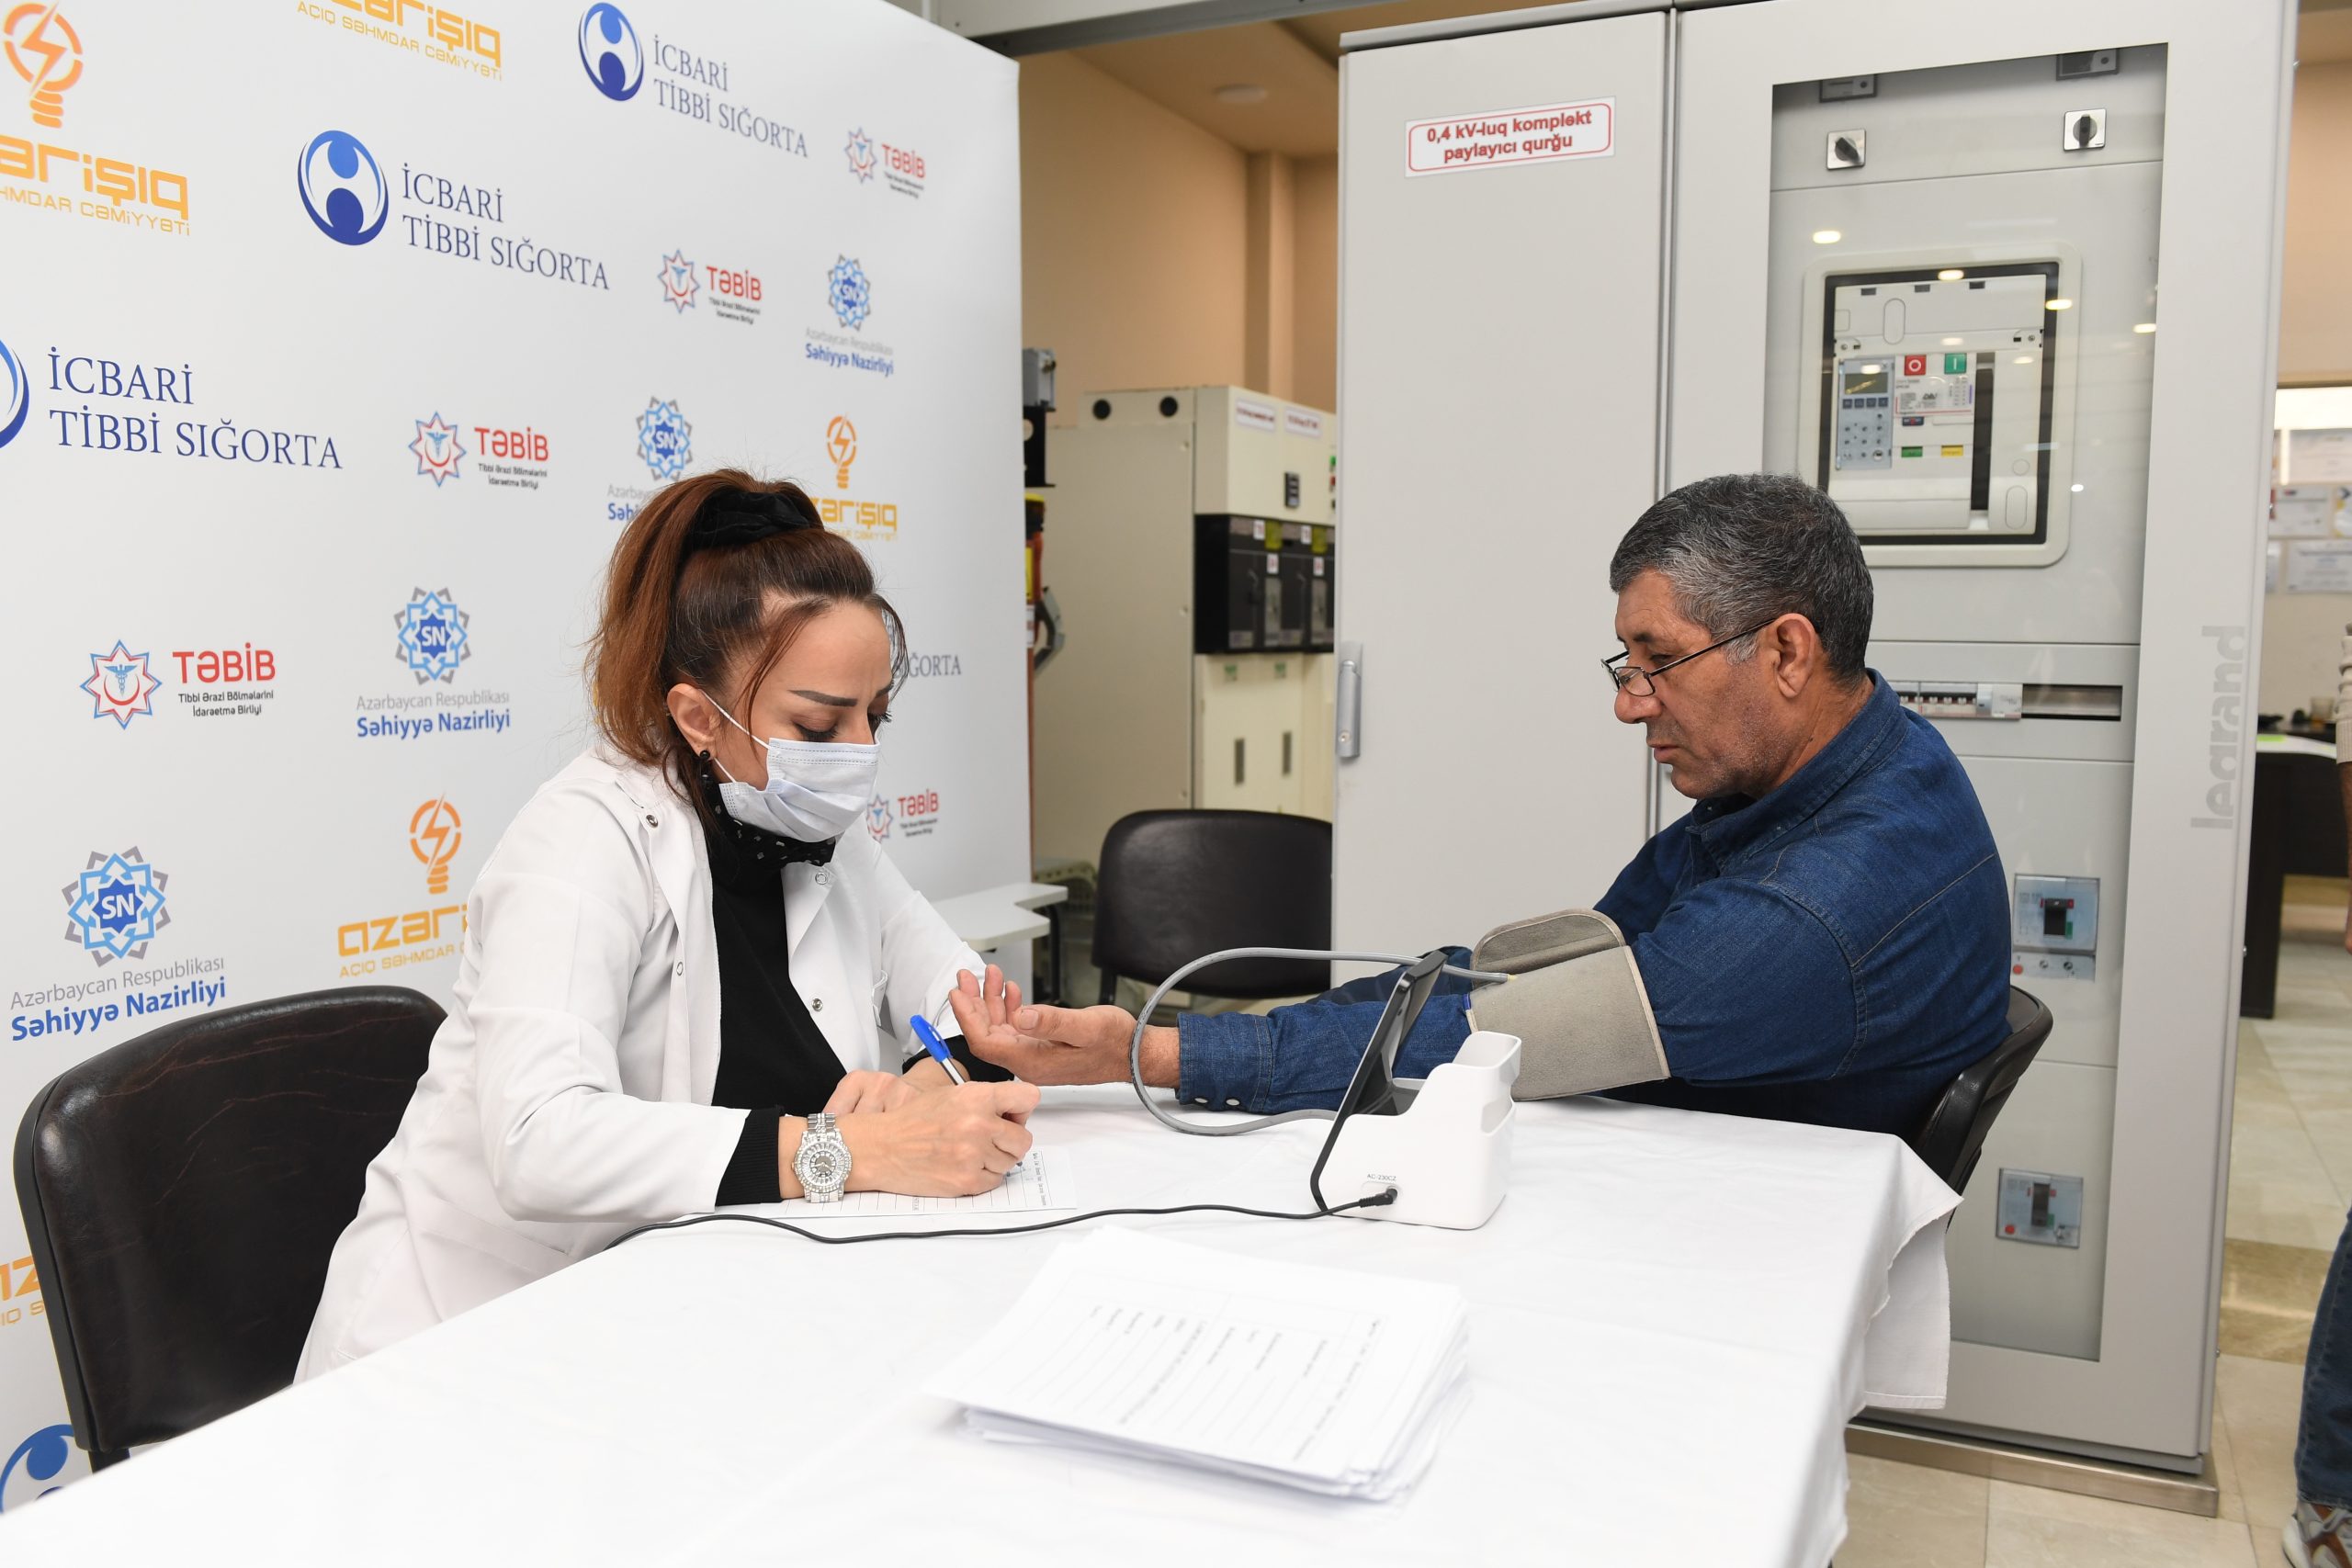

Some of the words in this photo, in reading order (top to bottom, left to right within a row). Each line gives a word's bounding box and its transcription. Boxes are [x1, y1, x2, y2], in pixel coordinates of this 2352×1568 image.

[297, 1, 336, 26] AÇIQ
[342, 15, 420, 53] SƏHMDAR
[653, 34, 729, 93] İCBARİ
[653, 78, 711, 123] TİBBİ
[718, 103, 809, 159] SIĞORTA
[1427, 126, 1451, 143] 0,4
[1455, 121, 1508, 138] kV-luq
[881, 142, 925, 179] TƏBİB
[1443, 141, 1518, 164] paylayıcı
[1521, 133, 1574, 153] qurğu
[401, 162, 504, 223] İCBARİ
[401, 213, 481, 262] TİBBİ
[490, 235, 610, 290] SIĞORTA
[706, 265, 762, 301] TƏBİB
[47, 345, 195, 406] İCBARİ
[49, 404, 163, 454] TİBBİ
[175, 417, 345, 470] SIĞORTA
[474, 426, 548, 462] TƏBİB
[654, 431, 675, 450] SN
[420, 625, 447, 648] SN
[172, 642, 276, 684] TƏBİB
[356, 694, 433, 714] Azərbaycan
[435, 690, 511, 709] Respublikası
[356, 715, 434, 741] Səhiyyə
[437, 708, 511, 734] Nazirliyi
[897, 788, 939, 818] TƏBİB
[100, 892, 136, 921] SN
[9, 976, 119, 1011] Azərbaycan
[121, 955, 225, 988] Respublikası
[10, 1006, 120, 1043] Səhiyyə
[125, 976, 227, 1019] Nazirliyi
